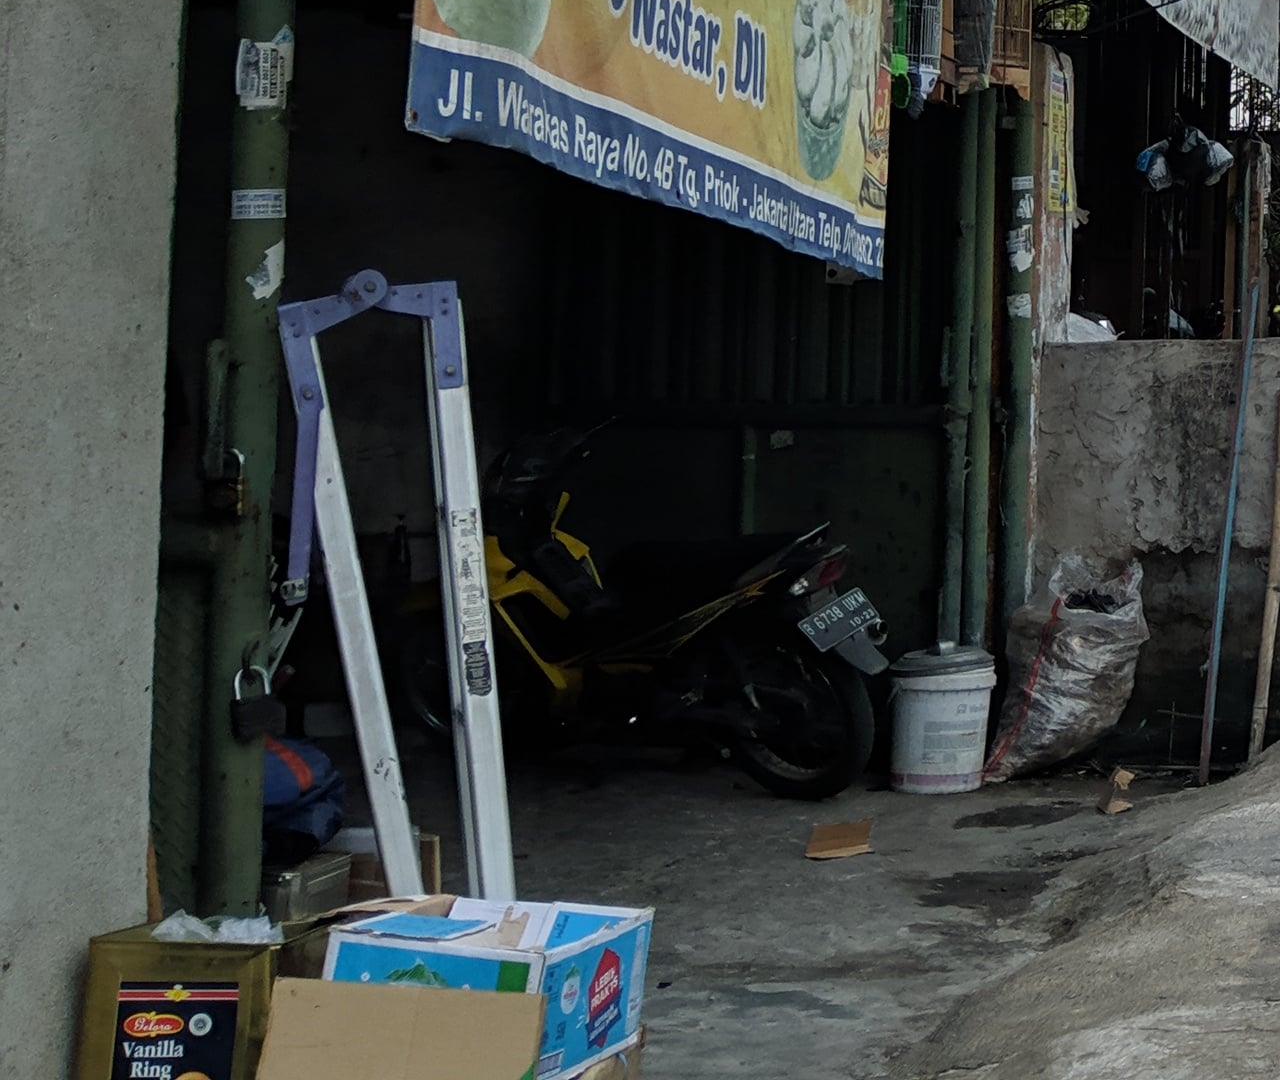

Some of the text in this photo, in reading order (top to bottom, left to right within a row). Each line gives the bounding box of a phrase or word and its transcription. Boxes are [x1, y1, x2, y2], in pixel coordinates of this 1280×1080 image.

[497, 78, 570, 154] Warakas
[574, 114, 620, 178] Raya
[624, 133, 650, 183] No.
[654, 146, 675, 190] 4B
[705, 165, 740, 213] Priok
[749, 184, 788, 231] Jakarta
[788, 200, 815, 242] Utara
[803, 623, 815, 635] B
[813, 606, 844, 630] 6738
[122, 1040, 184, 1058] Vanilla
[129, 1061, 172, 1080] Ring
